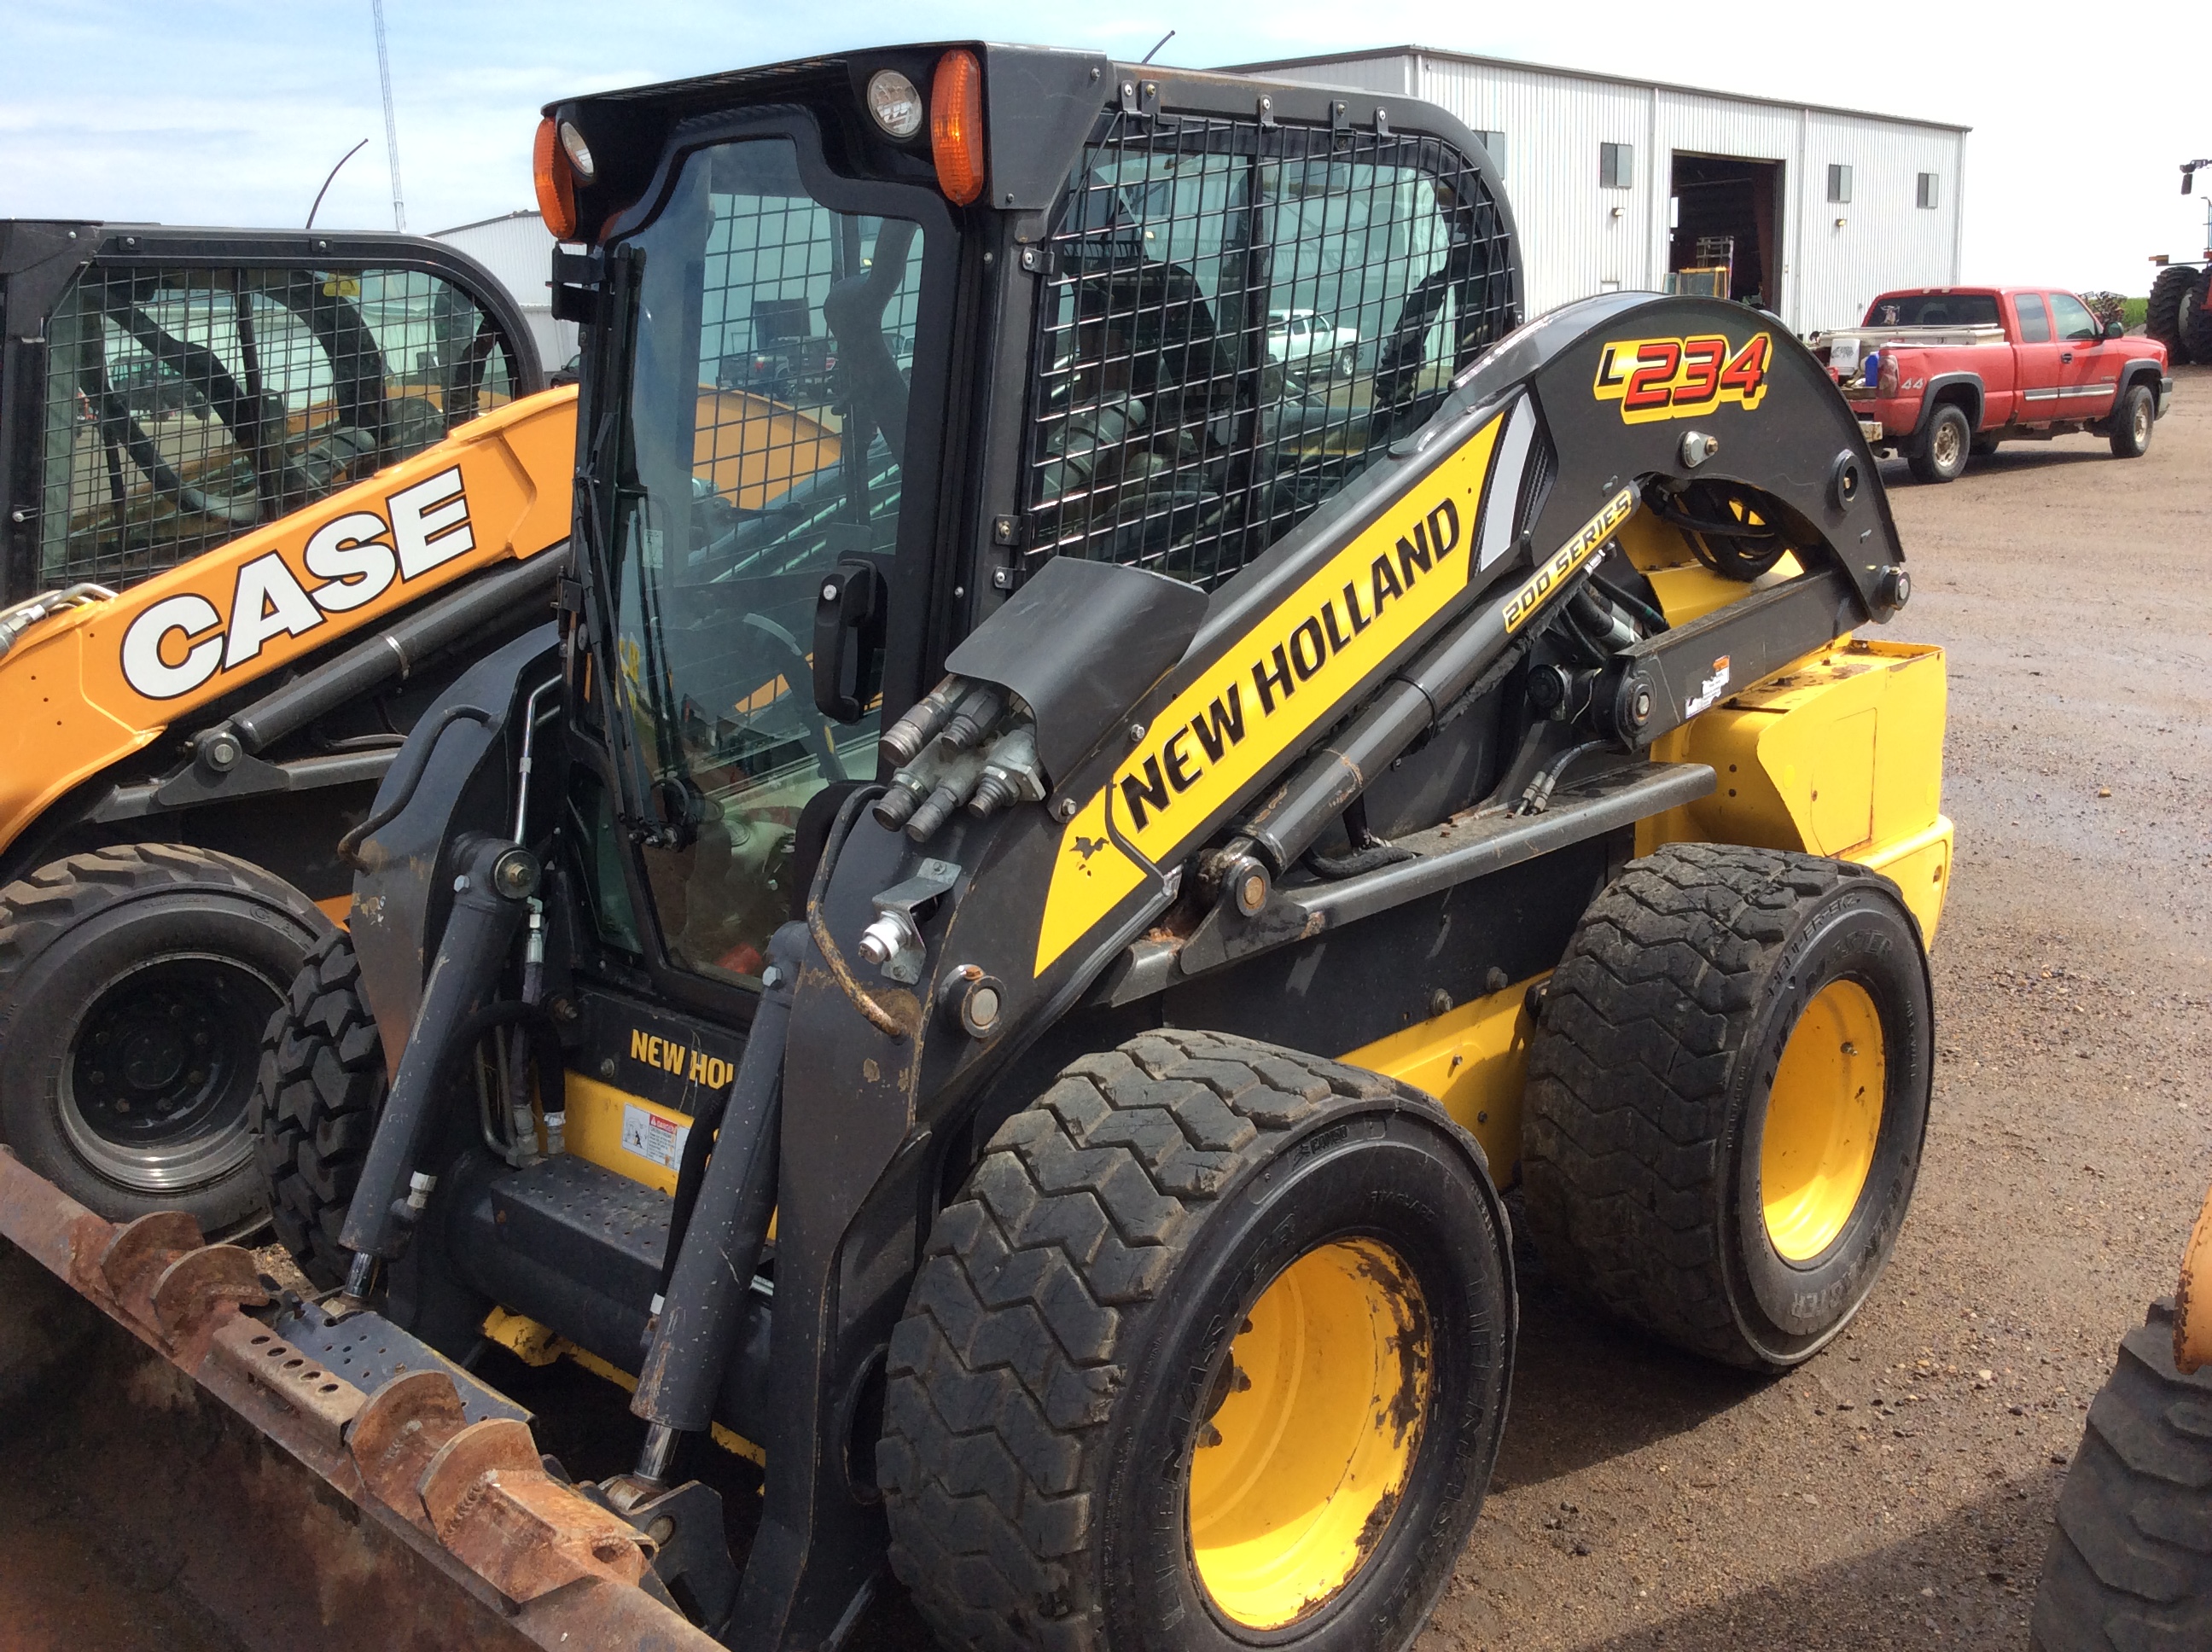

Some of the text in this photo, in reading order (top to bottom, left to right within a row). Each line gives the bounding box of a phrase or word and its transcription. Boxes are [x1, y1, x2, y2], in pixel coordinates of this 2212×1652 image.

[1596, 333, 1771, 416] L234
[119, 463, 476, 701] CASE
[1504, 490, 1633, 629] 200 SERIES
[1119, 496, 1462, 833] NEW HOLLAND
[631, 1028, 686, 1076] NEW
